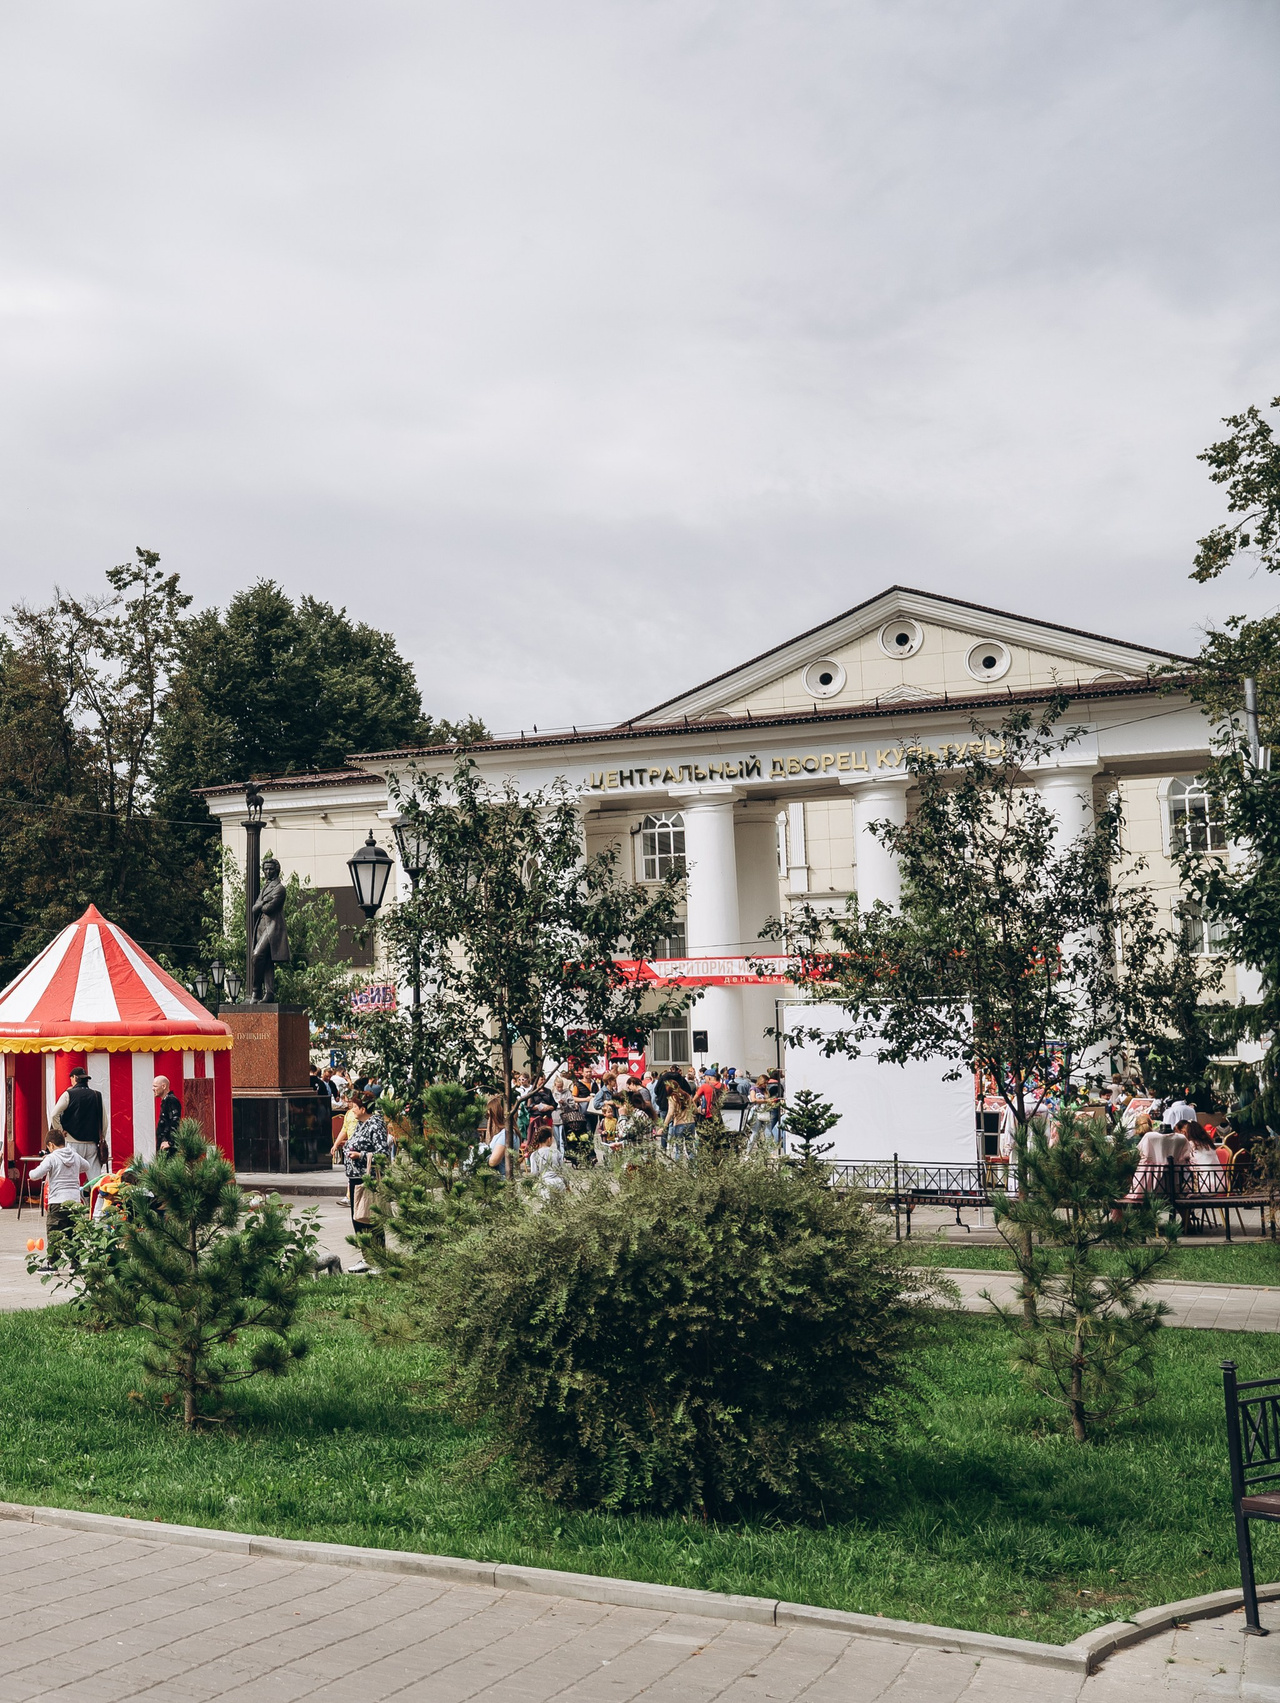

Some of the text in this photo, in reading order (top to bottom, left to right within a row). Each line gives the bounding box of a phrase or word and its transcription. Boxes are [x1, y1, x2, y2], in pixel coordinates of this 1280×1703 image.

[589, 755, 762, 790] ЦЕНТРАЛЬНЫЙ
[770, 750, 869, 779] ДВОРЕЦ
[657, 960, 734, 976] ТЕРРИТОРИЯ
[724, 976, 754, 984] день
[237, 1031, 272, 1041] ПУШКИНУ
